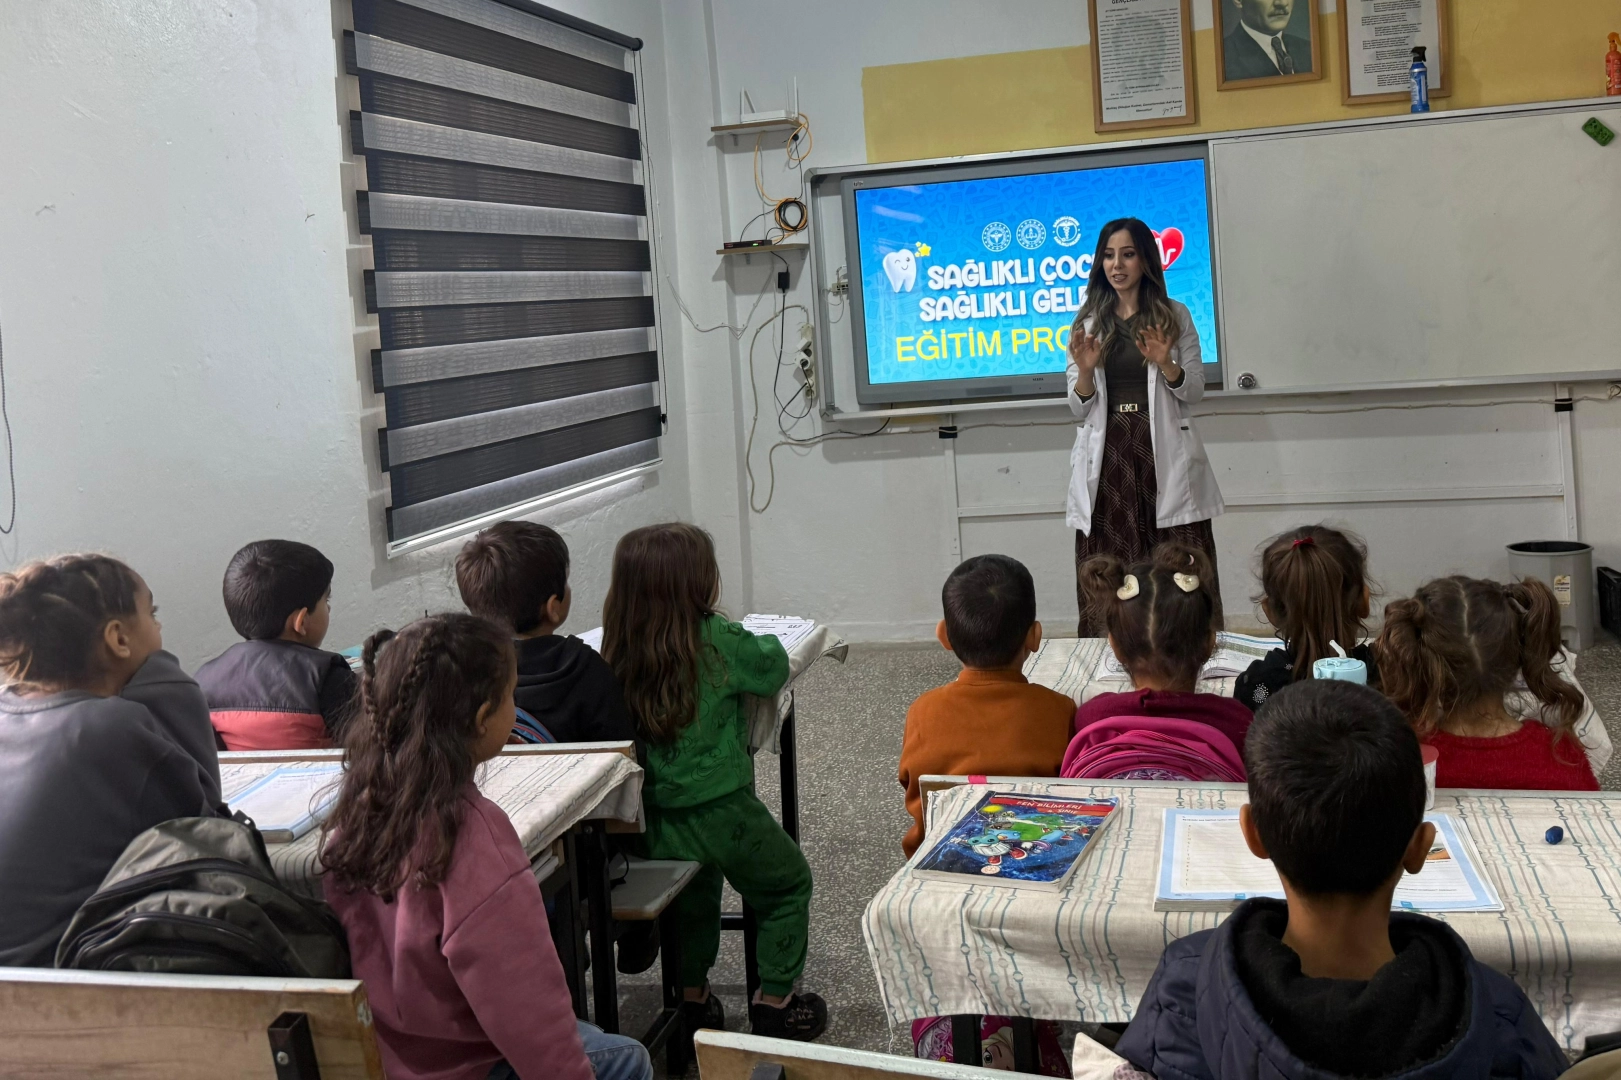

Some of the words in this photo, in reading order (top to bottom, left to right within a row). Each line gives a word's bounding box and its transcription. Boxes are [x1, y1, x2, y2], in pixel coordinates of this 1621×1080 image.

[927, 257, 1036, 290] SAĞLIKLI
[1039, 253, 1095, 286] ÇOC
[919, 290, 1027, 322] SAĞLIKLI
[896, 327, 1002, 362] EĞİTİM
